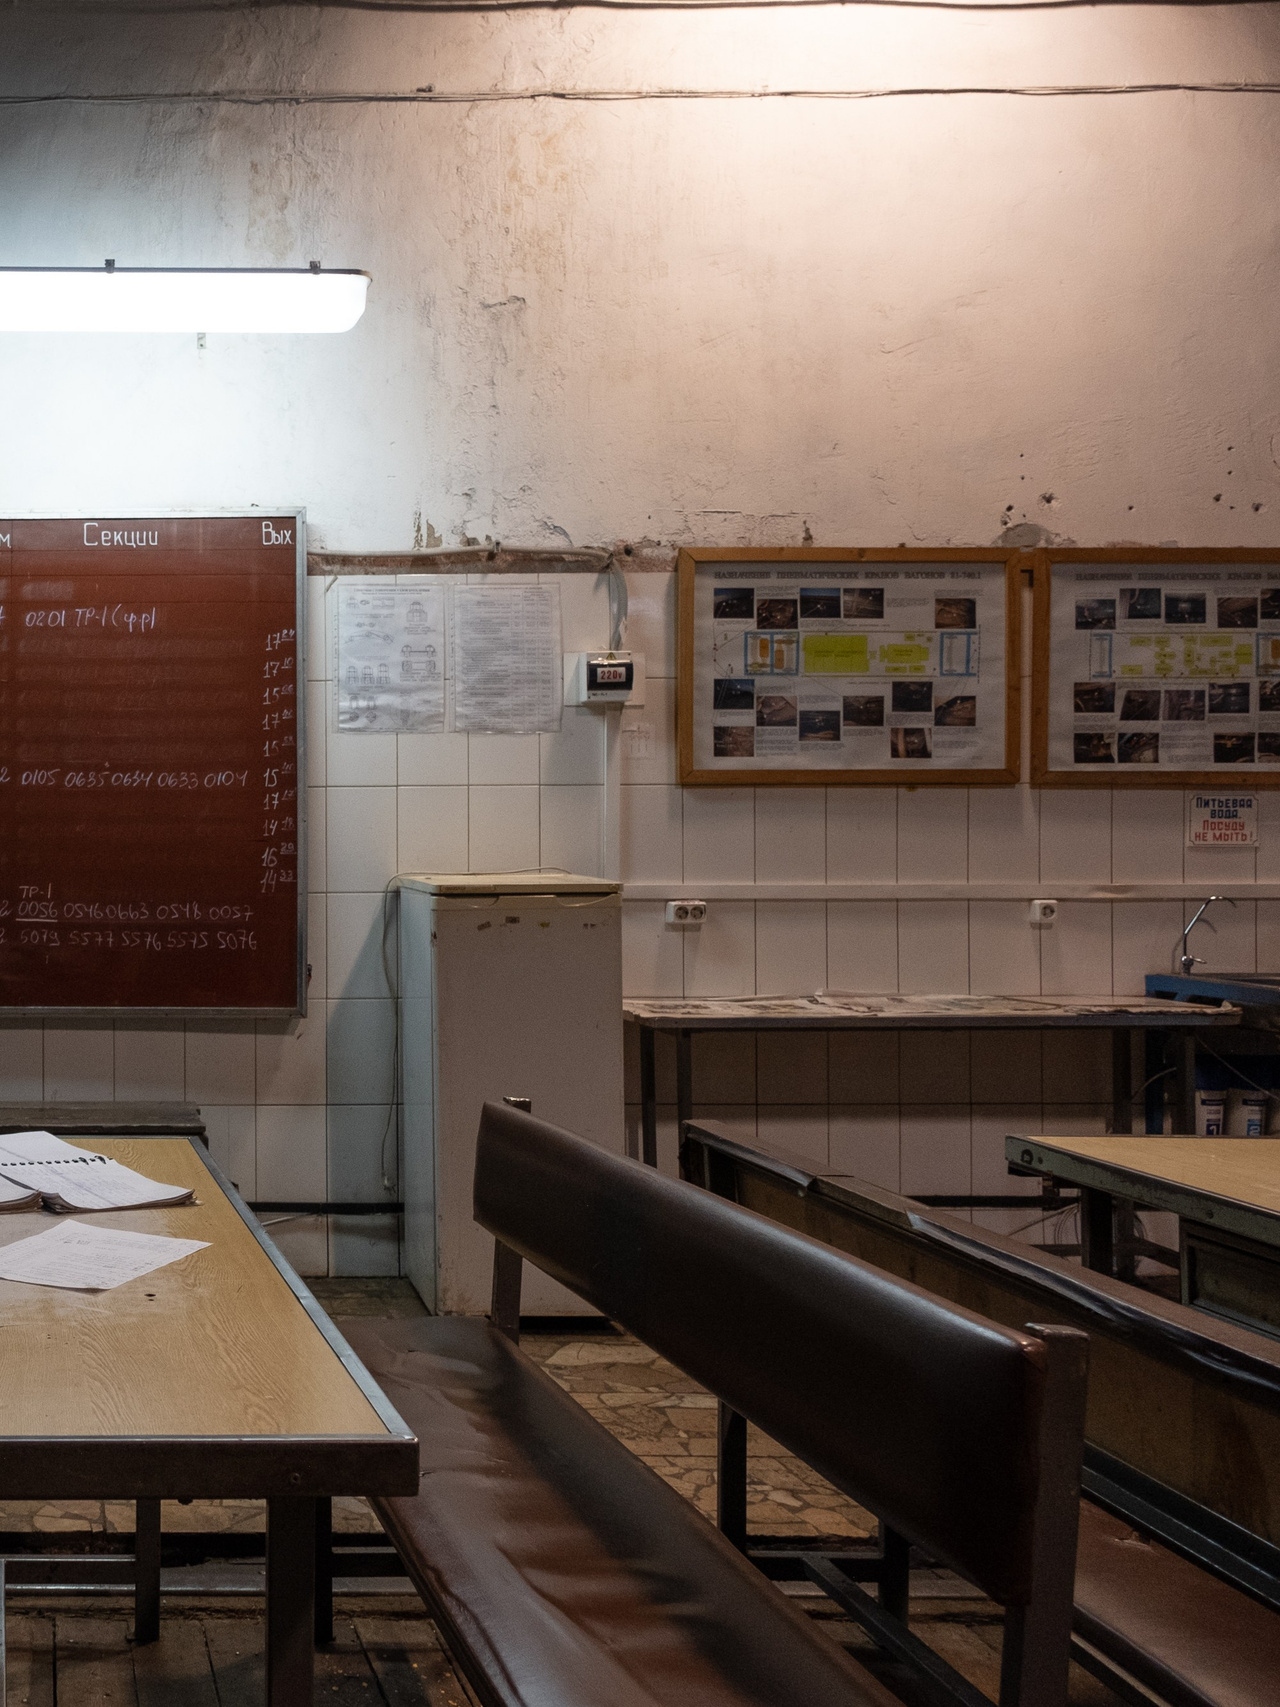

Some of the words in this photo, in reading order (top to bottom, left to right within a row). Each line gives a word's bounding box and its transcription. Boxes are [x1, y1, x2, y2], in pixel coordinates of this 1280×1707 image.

[83, 522, 158, 548] Секции
[25, 610, 66, 627] 0201
[21, 769, 61, 785] 0105
[1203, 819, 1245, 831] ПОСУДУ
[1195, 832, 1208, 842] НЕ
